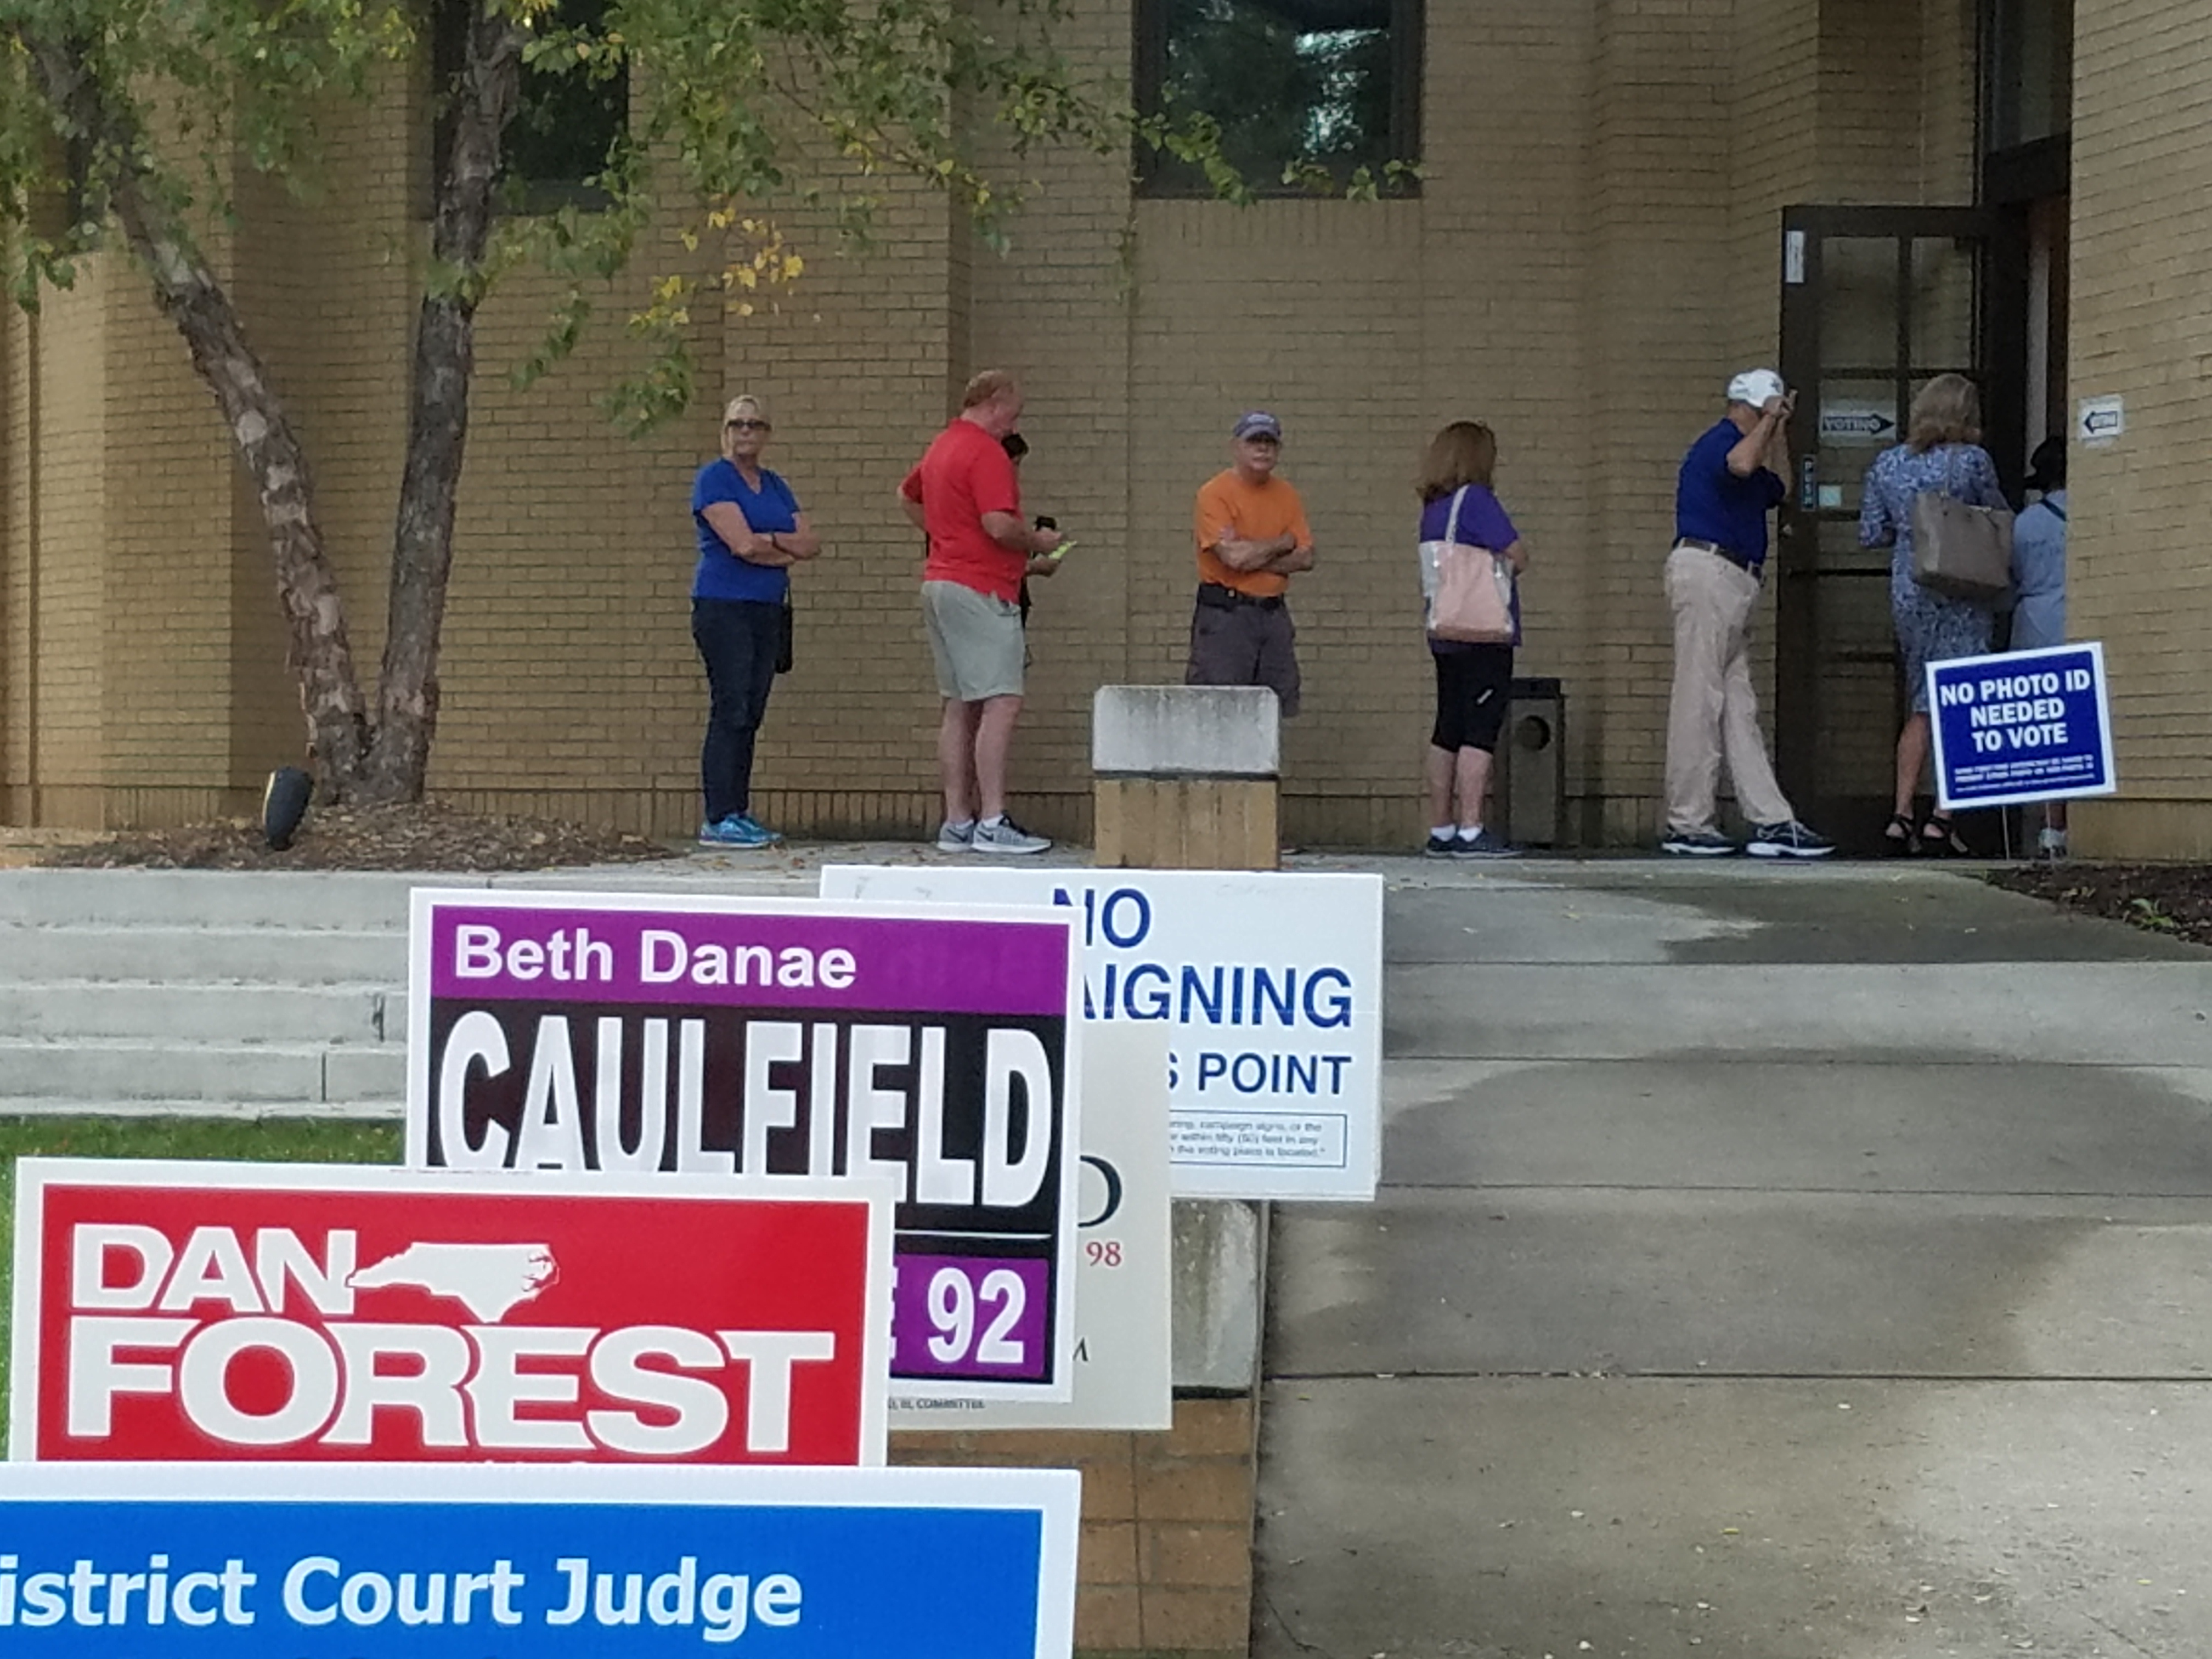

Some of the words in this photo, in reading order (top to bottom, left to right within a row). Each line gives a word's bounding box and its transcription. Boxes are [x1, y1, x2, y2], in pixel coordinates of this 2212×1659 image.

[1939, 682, 1974, 706] NO
[1979, 673, 2059, 702] PHOTO
[2065, 669, 2091, 692] ID
[1971, 697, 2065, 727] NEEDED
[1971, 730, 2002, 753] TO
[2006, 723, 2068, 749] VOTE
[455, 924, 613, 981] Beth
[640, 929, 857, 989] Danae
[1084, 963, 1352, 1028] IGNING
[1198, 1053, 1352, 1094] POINT
[439, 1011, 1052, 1207] CAULFIELD
[72, 1223, 356, 1314] DAN
[1086, 1242, 1121, 1267] 98
[928, 1267, 1026, 1364] 92
[67, 1316, 835, 1455] FOREST
[283, 1556, 525, 1626] Court
[546, 1556, 802, 1643] Judge
